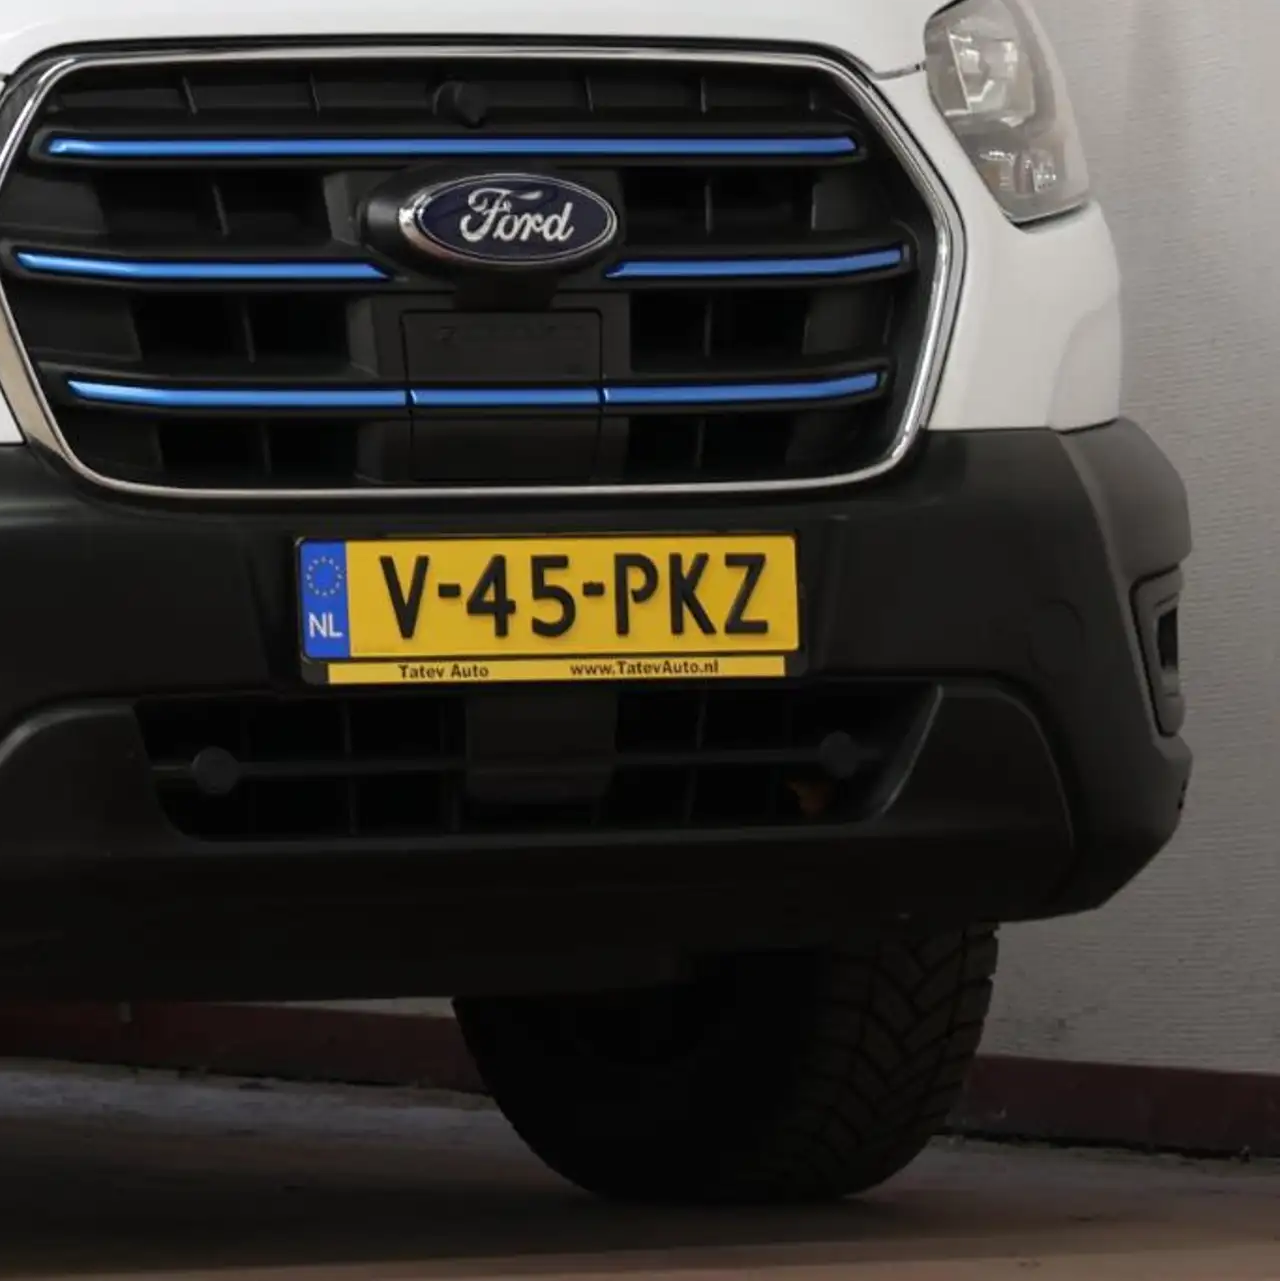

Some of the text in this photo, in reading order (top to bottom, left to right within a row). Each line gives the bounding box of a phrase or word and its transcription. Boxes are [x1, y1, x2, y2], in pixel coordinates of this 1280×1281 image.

[460, 187, 575, 243] Ford
[378, 552, 769, 640] V-45-PKZ
[308, 611, 344, 639] NL
[398, 659, 719, 680] Tatev Auto www.TatevAuto.nl
